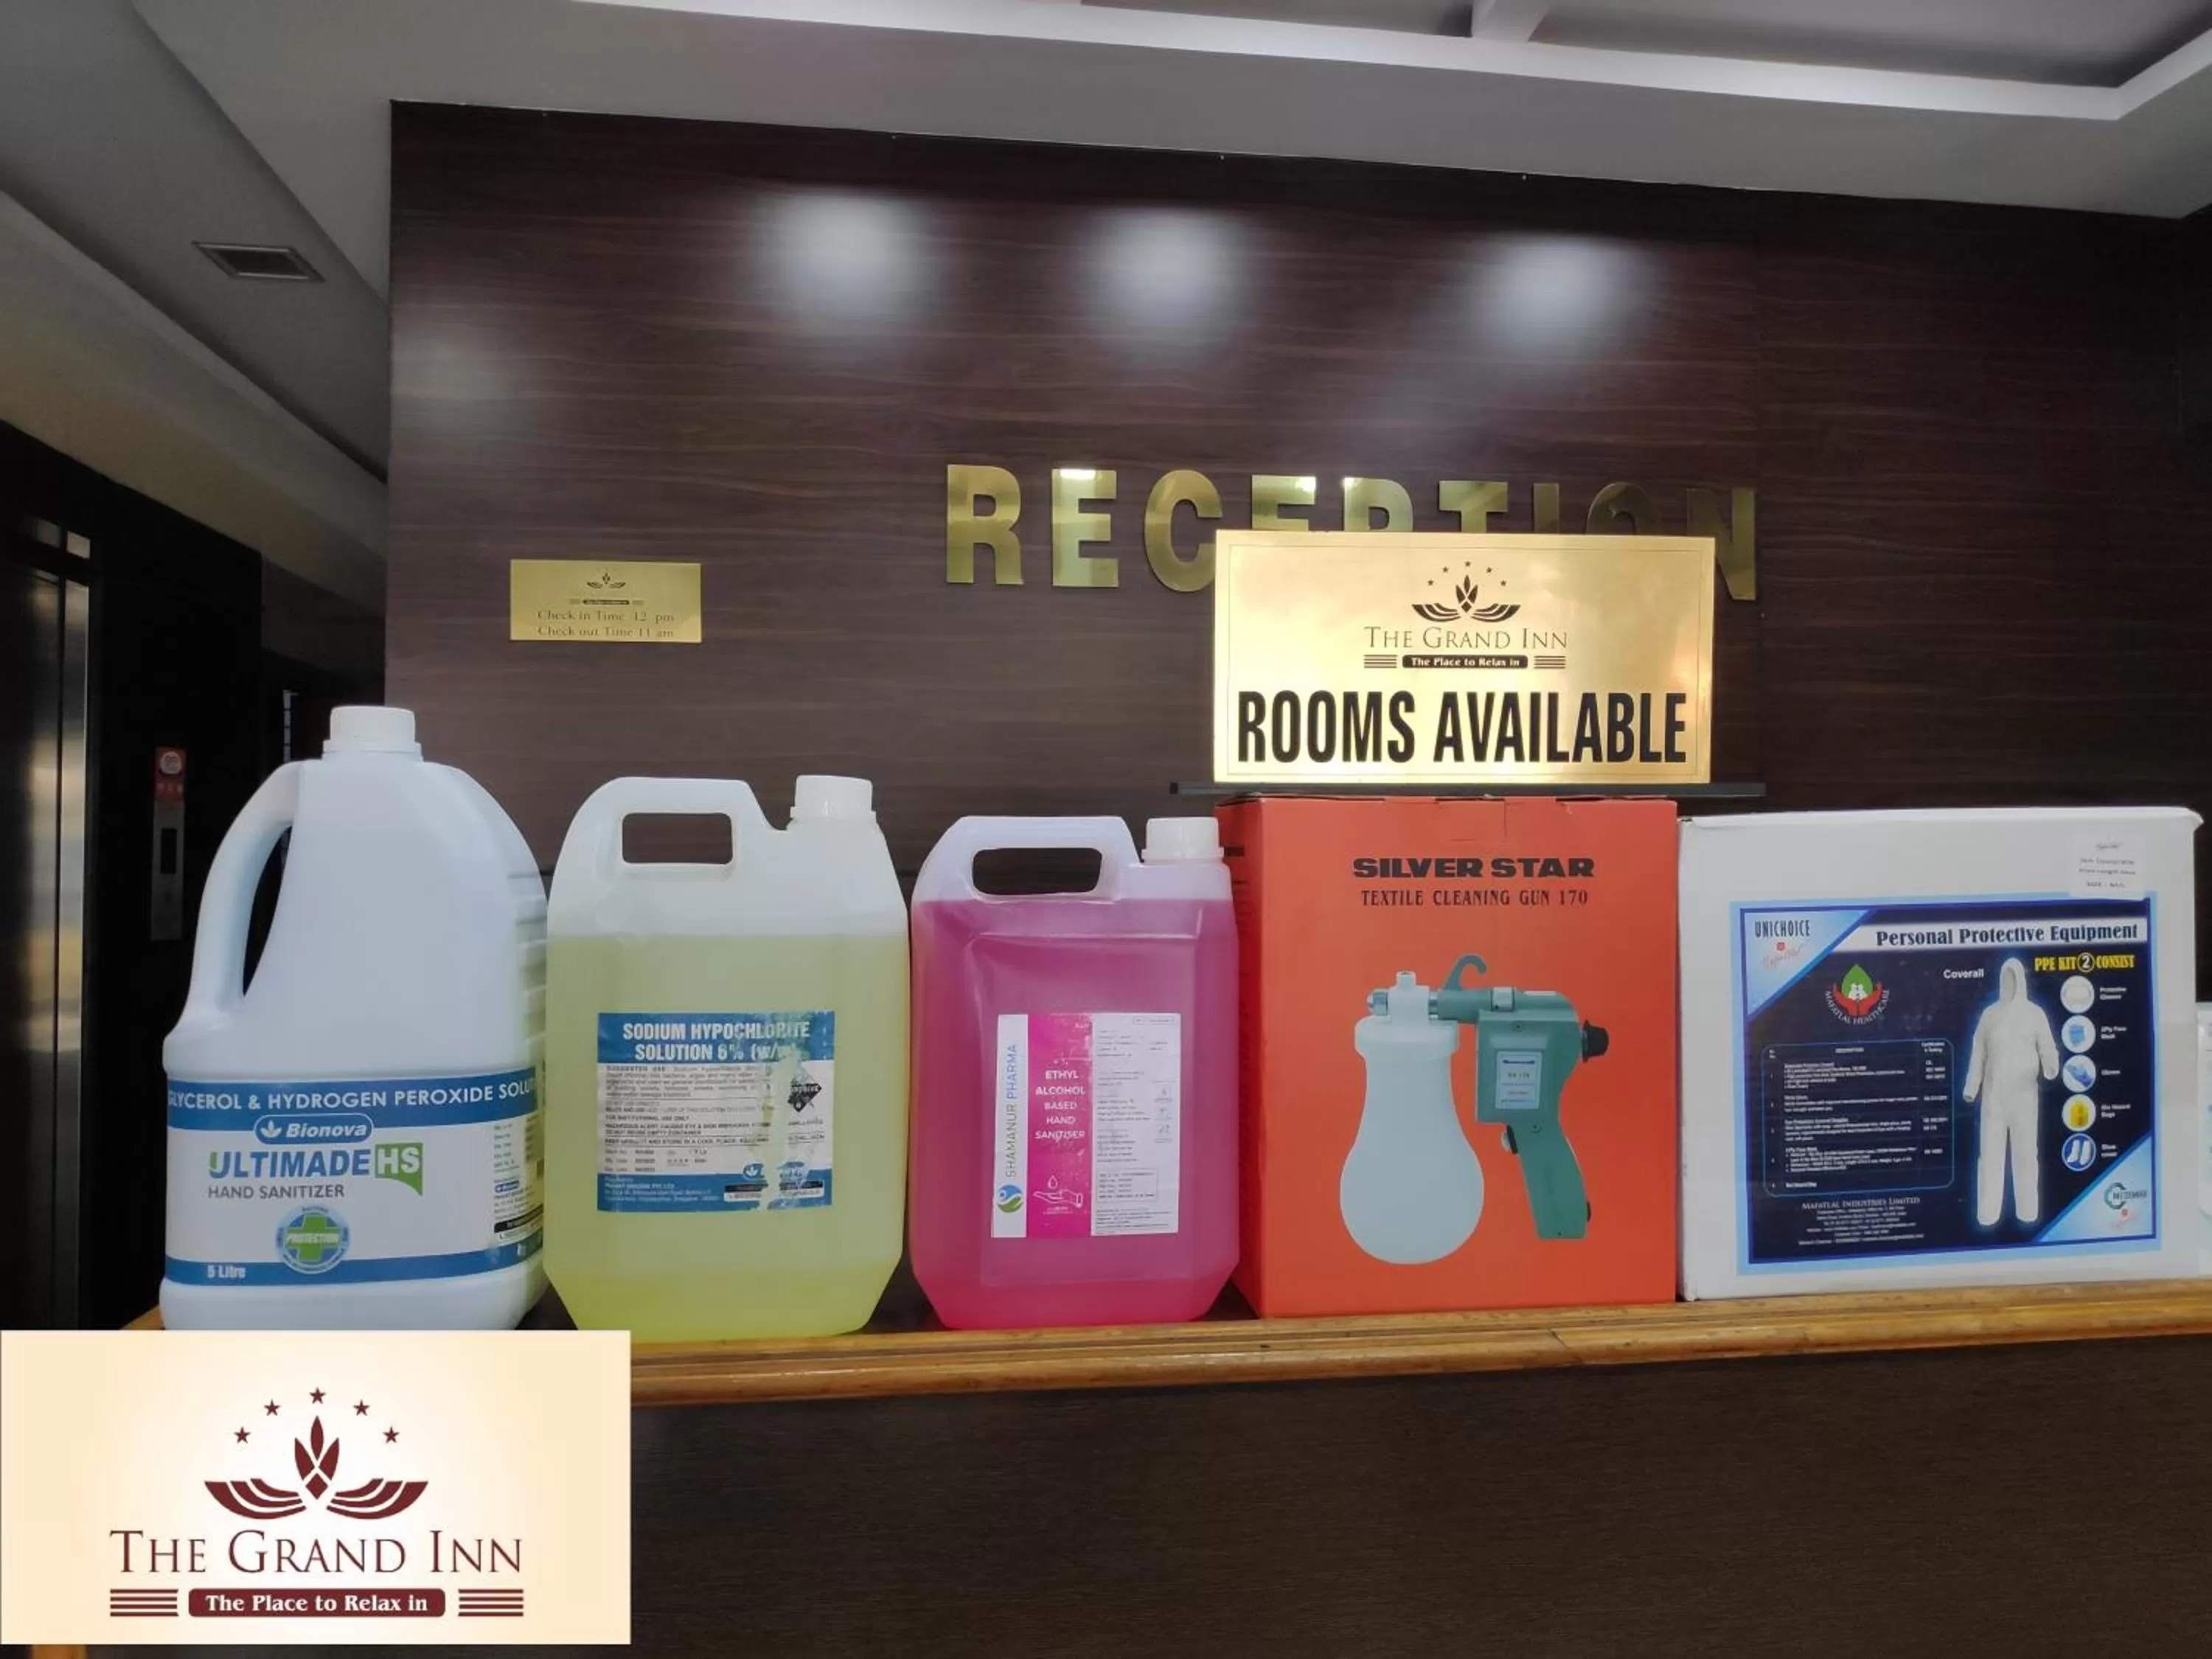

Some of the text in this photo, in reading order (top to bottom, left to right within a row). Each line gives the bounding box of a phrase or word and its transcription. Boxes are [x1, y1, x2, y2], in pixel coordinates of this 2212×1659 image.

[537, 610, 577, 621] Check
[579, 611, 591, 621] in
[635, 611, 647, 622] 12
[654, 613, 675, 625] pm
[537, 626, 577, 637] Check
[579, 627, 599, 637] out
[639, 627, 650, 638] 11
[656, 630, 674, 638] am
[1411, 657, 1520, 667] The Place to Relax in
[1237, 689, 1687, 764] ROOMS AVAILABLE
[1353, 858, 1595, 878] SILVER STAR
[1361, 890, 1588, 906] TEXTILE CLEANING GUN 170
[1754, 919, 1811, 938] UNICHOICE
[1876, 923, 2138, 947] Personal Protective Equipment
[2034, 956, 2056, 971] PPE
[2058, 956, 2076, 970] KIT
[2096, 955, 2135, 969] CONSIST
[1943, 968, 1984, 980] Coverall
[622, 1021, 810, 1040] SODIUM HYPOCHLORITE
[635, 1043, 713, 1061] SOLUTION
[1045, 1070, 1079, 1079] ETHYL
[168, 1091, 242, 1110] GLYCEROL
[248, 1094, 261, 1110] &
[268, 1091, 386, 1110] HYDROGEN
[394, 1085, 493, 1106] PEROXIDE
[1035, 1086, 1086, 1095] ALCOHOL
[1005, 1043, 1018, 1179] SHAMANUR PHARMA
[1044, 1102, 1077, 1110] BASED
[1046, 1116, 1076, 1124] HAND
[285, 1123, 367, 1138] Bionova
[1035, 1130, 1085, 1139] SANITISER
[209, 1147, 420, 1179] ULTIMADE HS
[208, 1184, 345, 1199] HAND SANITIZER
[207, 1265, 246, 1279] 5 Litre
